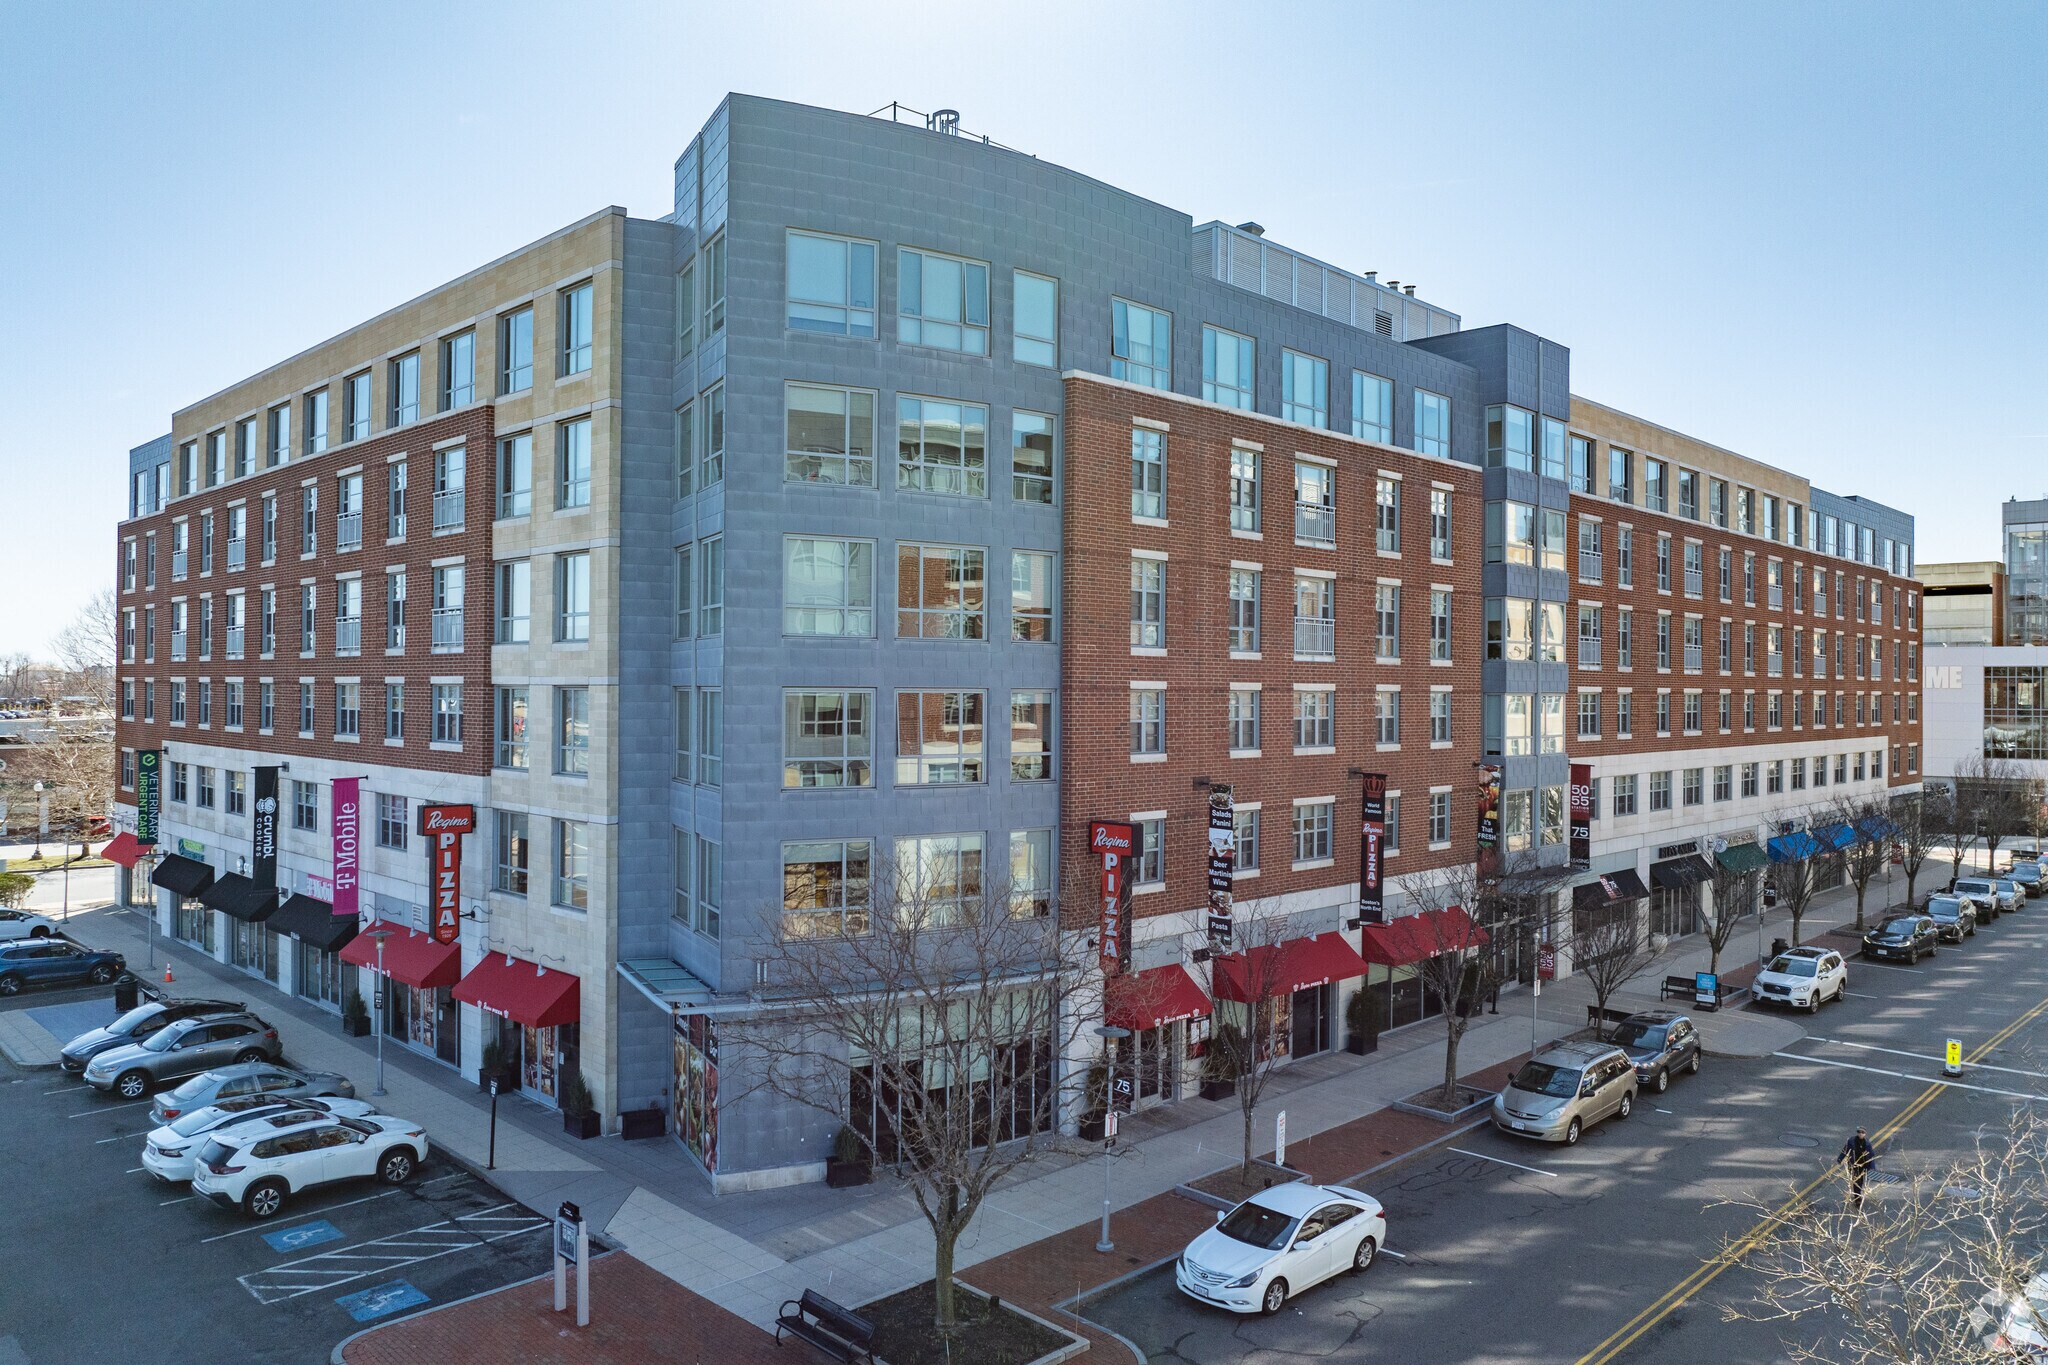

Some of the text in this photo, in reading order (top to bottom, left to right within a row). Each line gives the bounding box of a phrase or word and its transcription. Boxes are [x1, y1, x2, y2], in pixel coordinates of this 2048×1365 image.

[1571, 785, 1589, 796] 50
[138, 772, 148, 839] URGENT CARE
[149, 771, 158, 839] VETERINARY
[1571, 795, 1589, 806] 55
[427, 810, 469, 830] Regina
[1212, 810, 1231, 819] Salads
[1213, 819, 1231, 827] Panini
[1362, 823, 1382, 834] Regina
[255, 817, 263, 857] cookies
[263, 815, 274, 859] crumbl
[1478, 832, 1497, 841] FRESH
[1571, 826, 1589, 837] 75
[1094, 827, 1130, 848] Regina
[1367, 834, 1376, 880] PIZZA
[1213, 861, 1228, 869] Beer
[1209, 869, 1232, 878] Martinis
[439, 832, 456, 927] PIZZA
[1212, 878, 1228, 887] Wine
[1104, 853, 1118, 958] PIZZA
[1211, 921, 1228, 931] Pasta
[1117, 1079, 1130, 1092] 75
